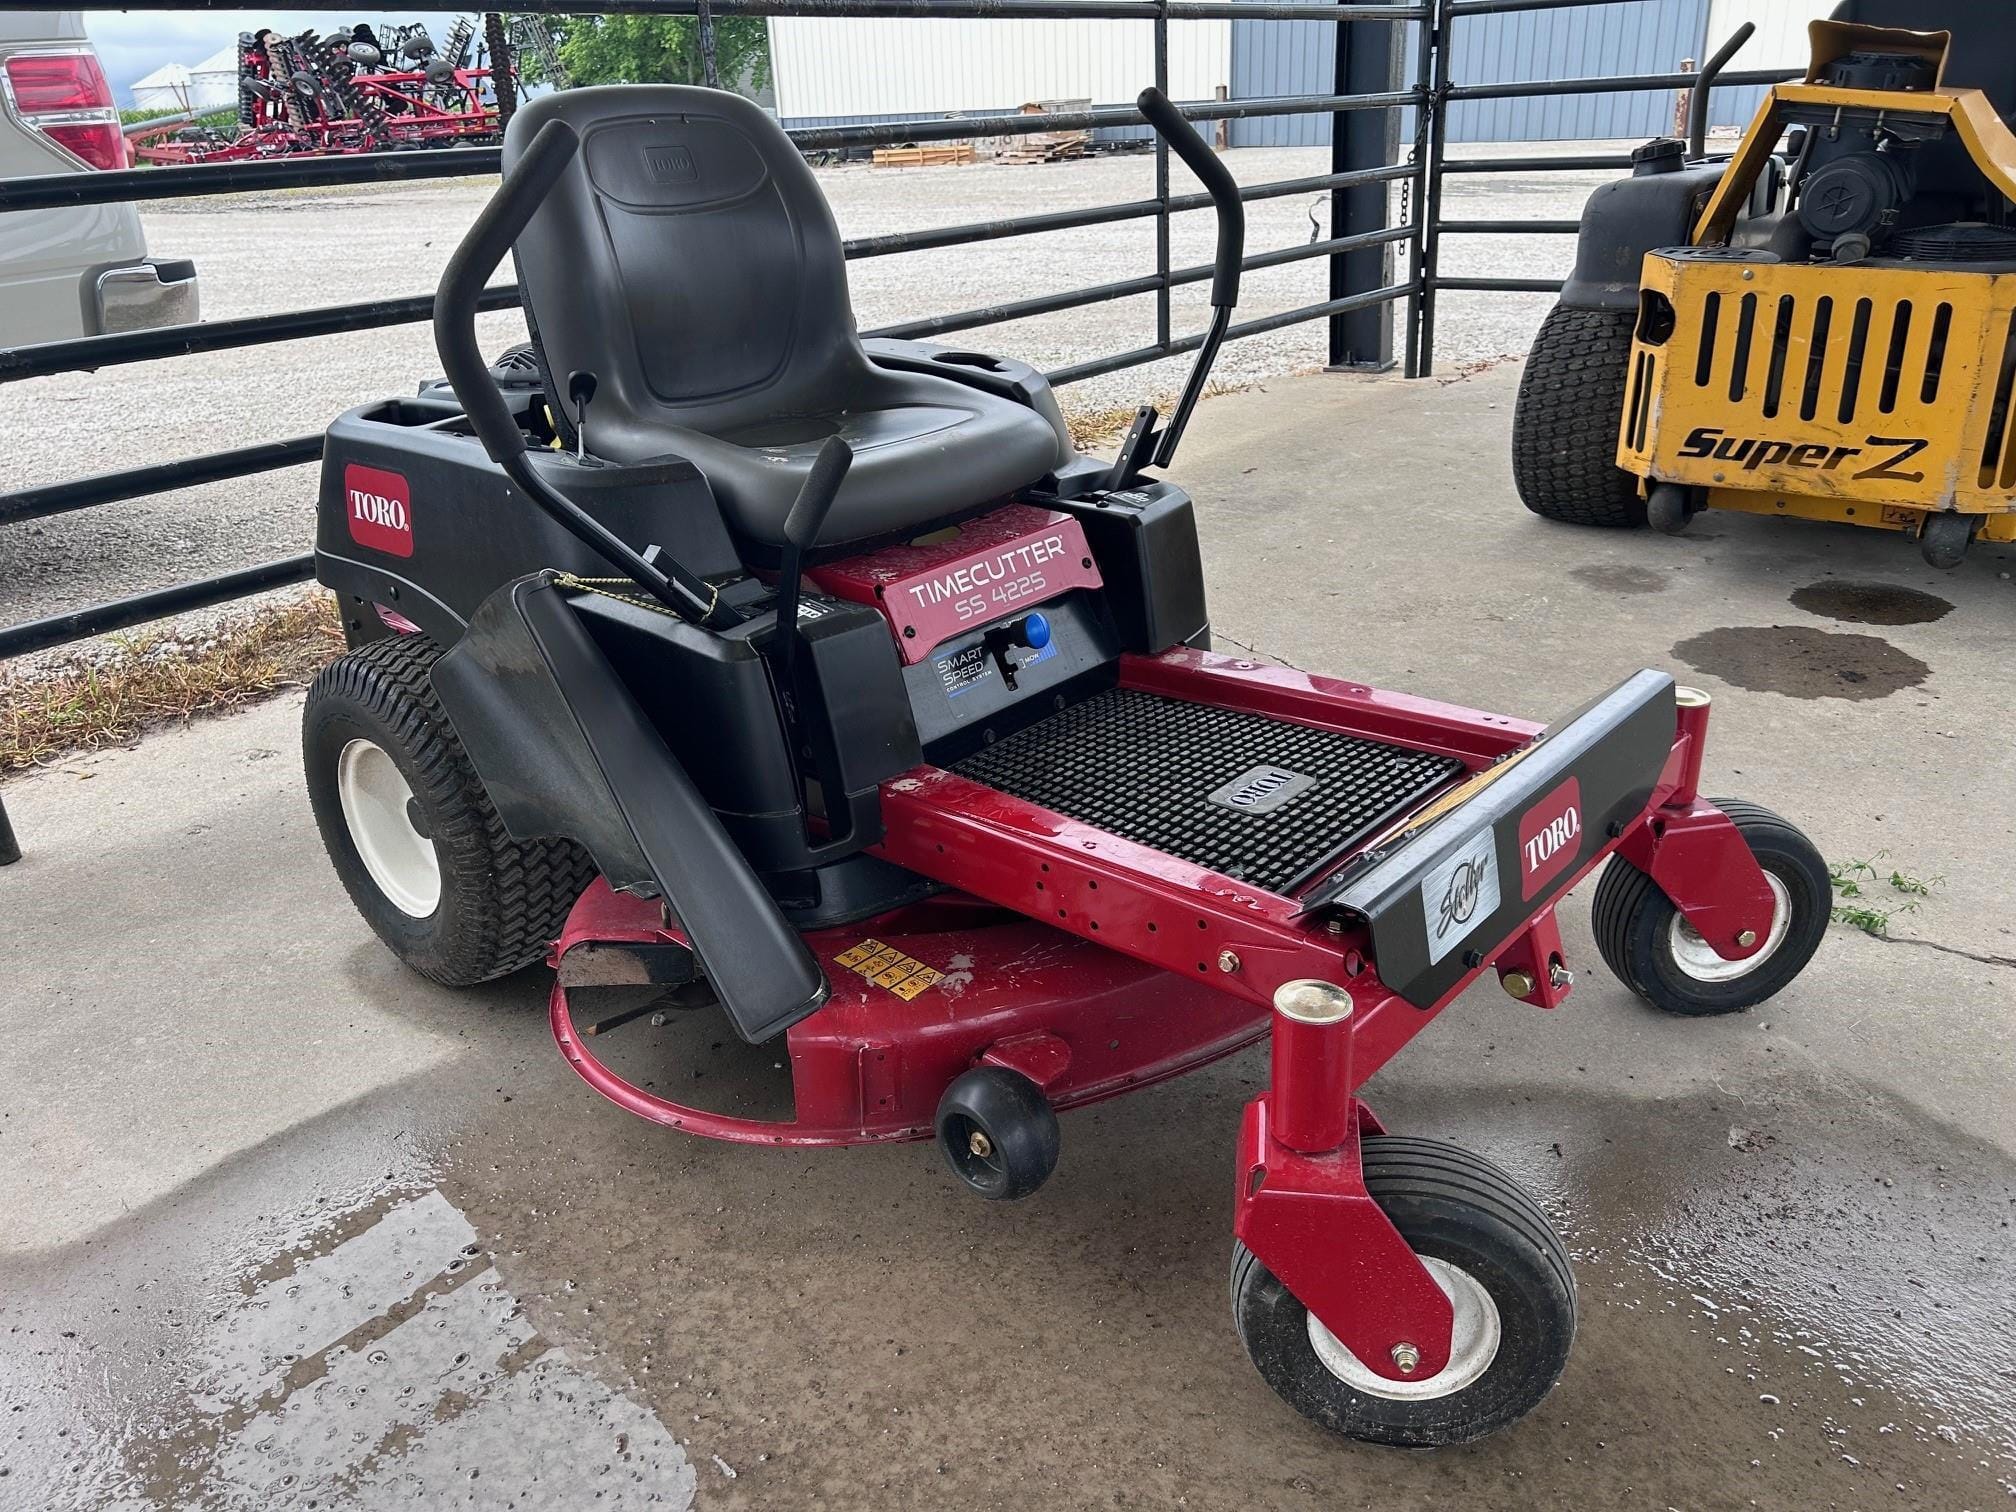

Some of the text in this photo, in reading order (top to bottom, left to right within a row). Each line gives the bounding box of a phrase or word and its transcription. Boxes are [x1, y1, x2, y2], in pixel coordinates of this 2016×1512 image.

[652, 158, 690, 171] TORO
[1677, 428, 1929, 483] Super Z
[350, 489, 405, 530] TORO
[909, 535, 1065, 608] TIMECUTTER
[955, 571, 1047, 621] SS 4225
[937, 647, 983, 674] SMART
[942, 662, 984, 687] SPEED
[947, 670, 992, 693] CONTROL SYSTEM
[1230, 772, 1296, 806] TORO
[1525, 806, 1578, 874] TORO
